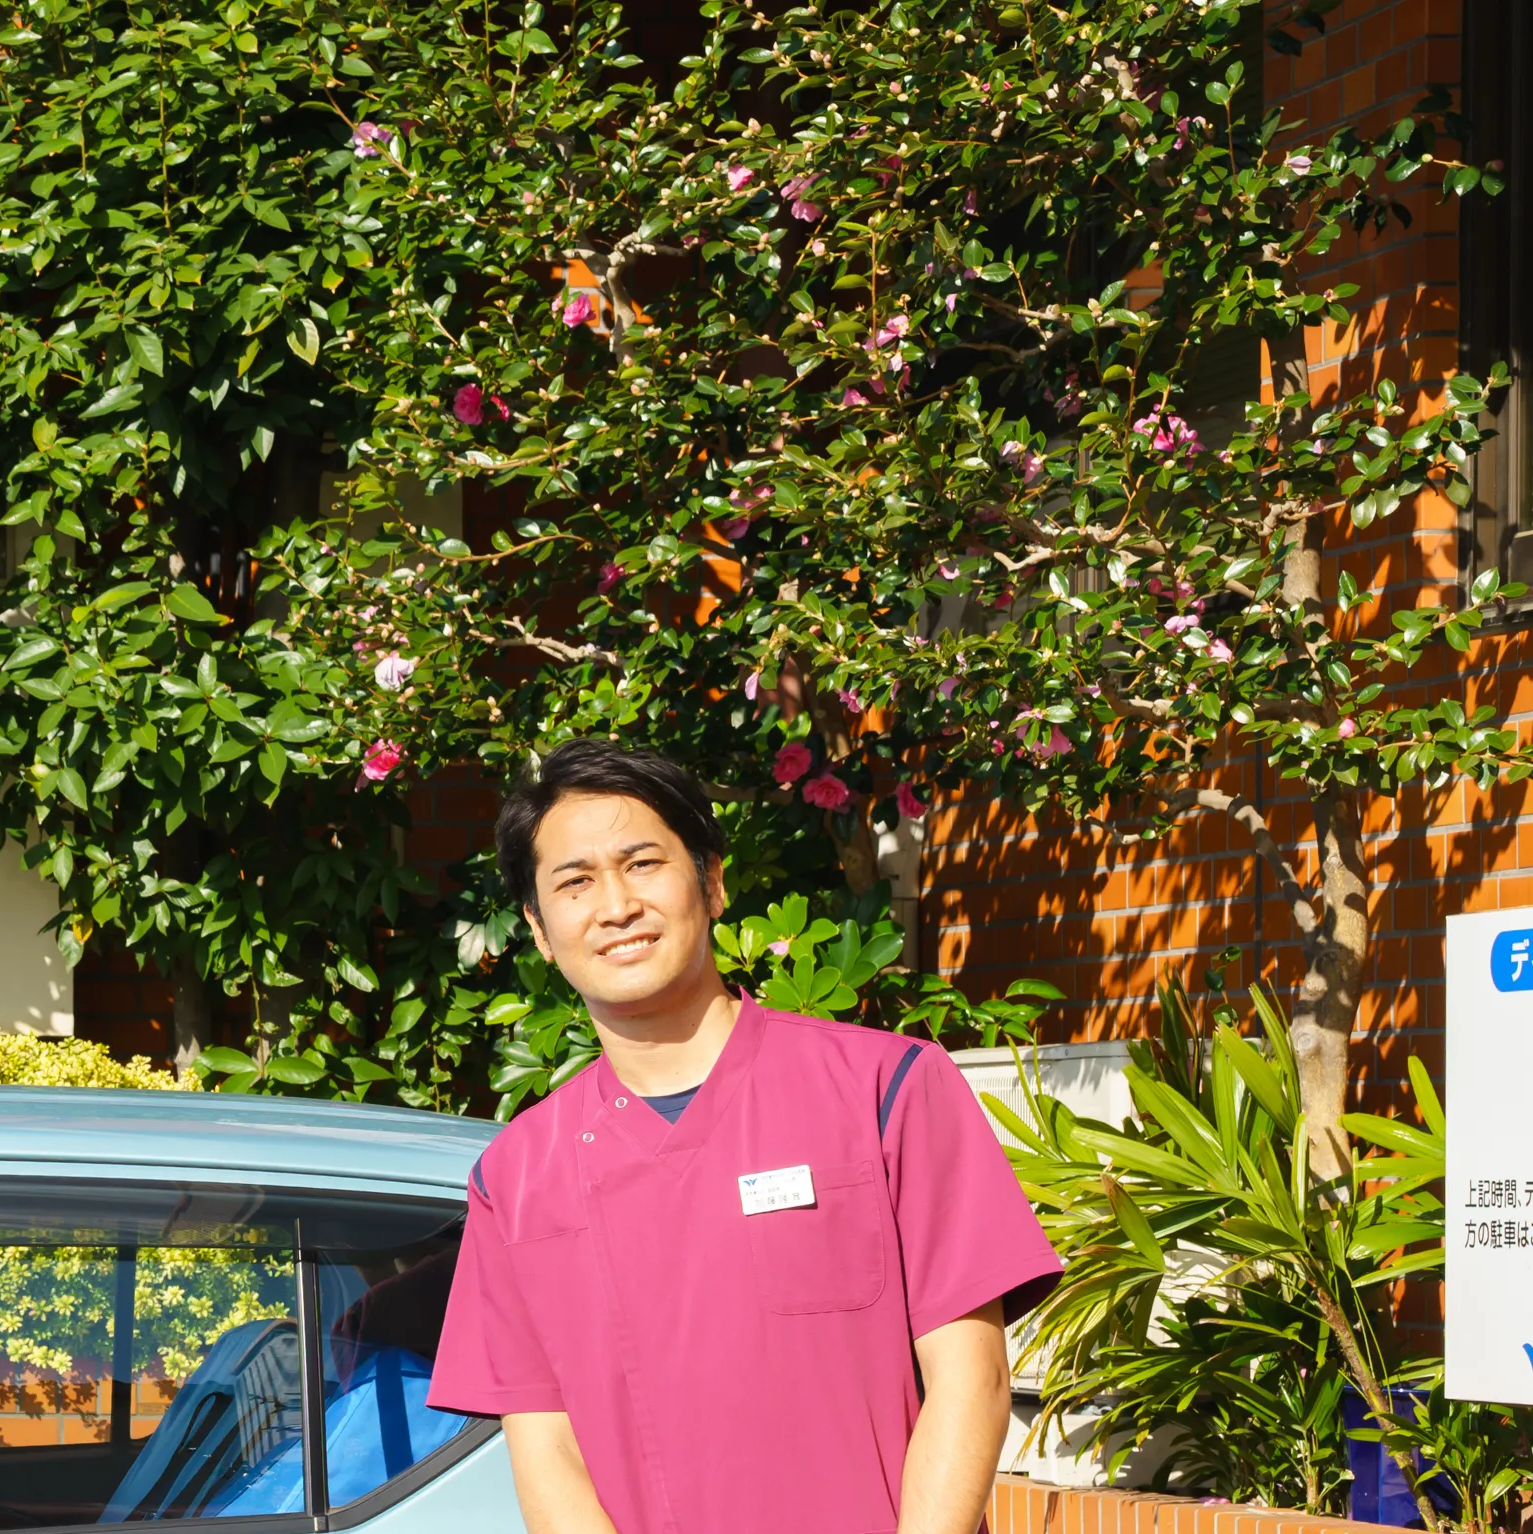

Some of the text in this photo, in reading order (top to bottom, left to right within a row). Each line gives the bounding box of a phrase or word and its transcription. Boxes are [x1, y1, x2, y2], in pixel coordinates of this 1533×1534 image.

[1464, 1219, 1533, 1249] 方の駐車は
